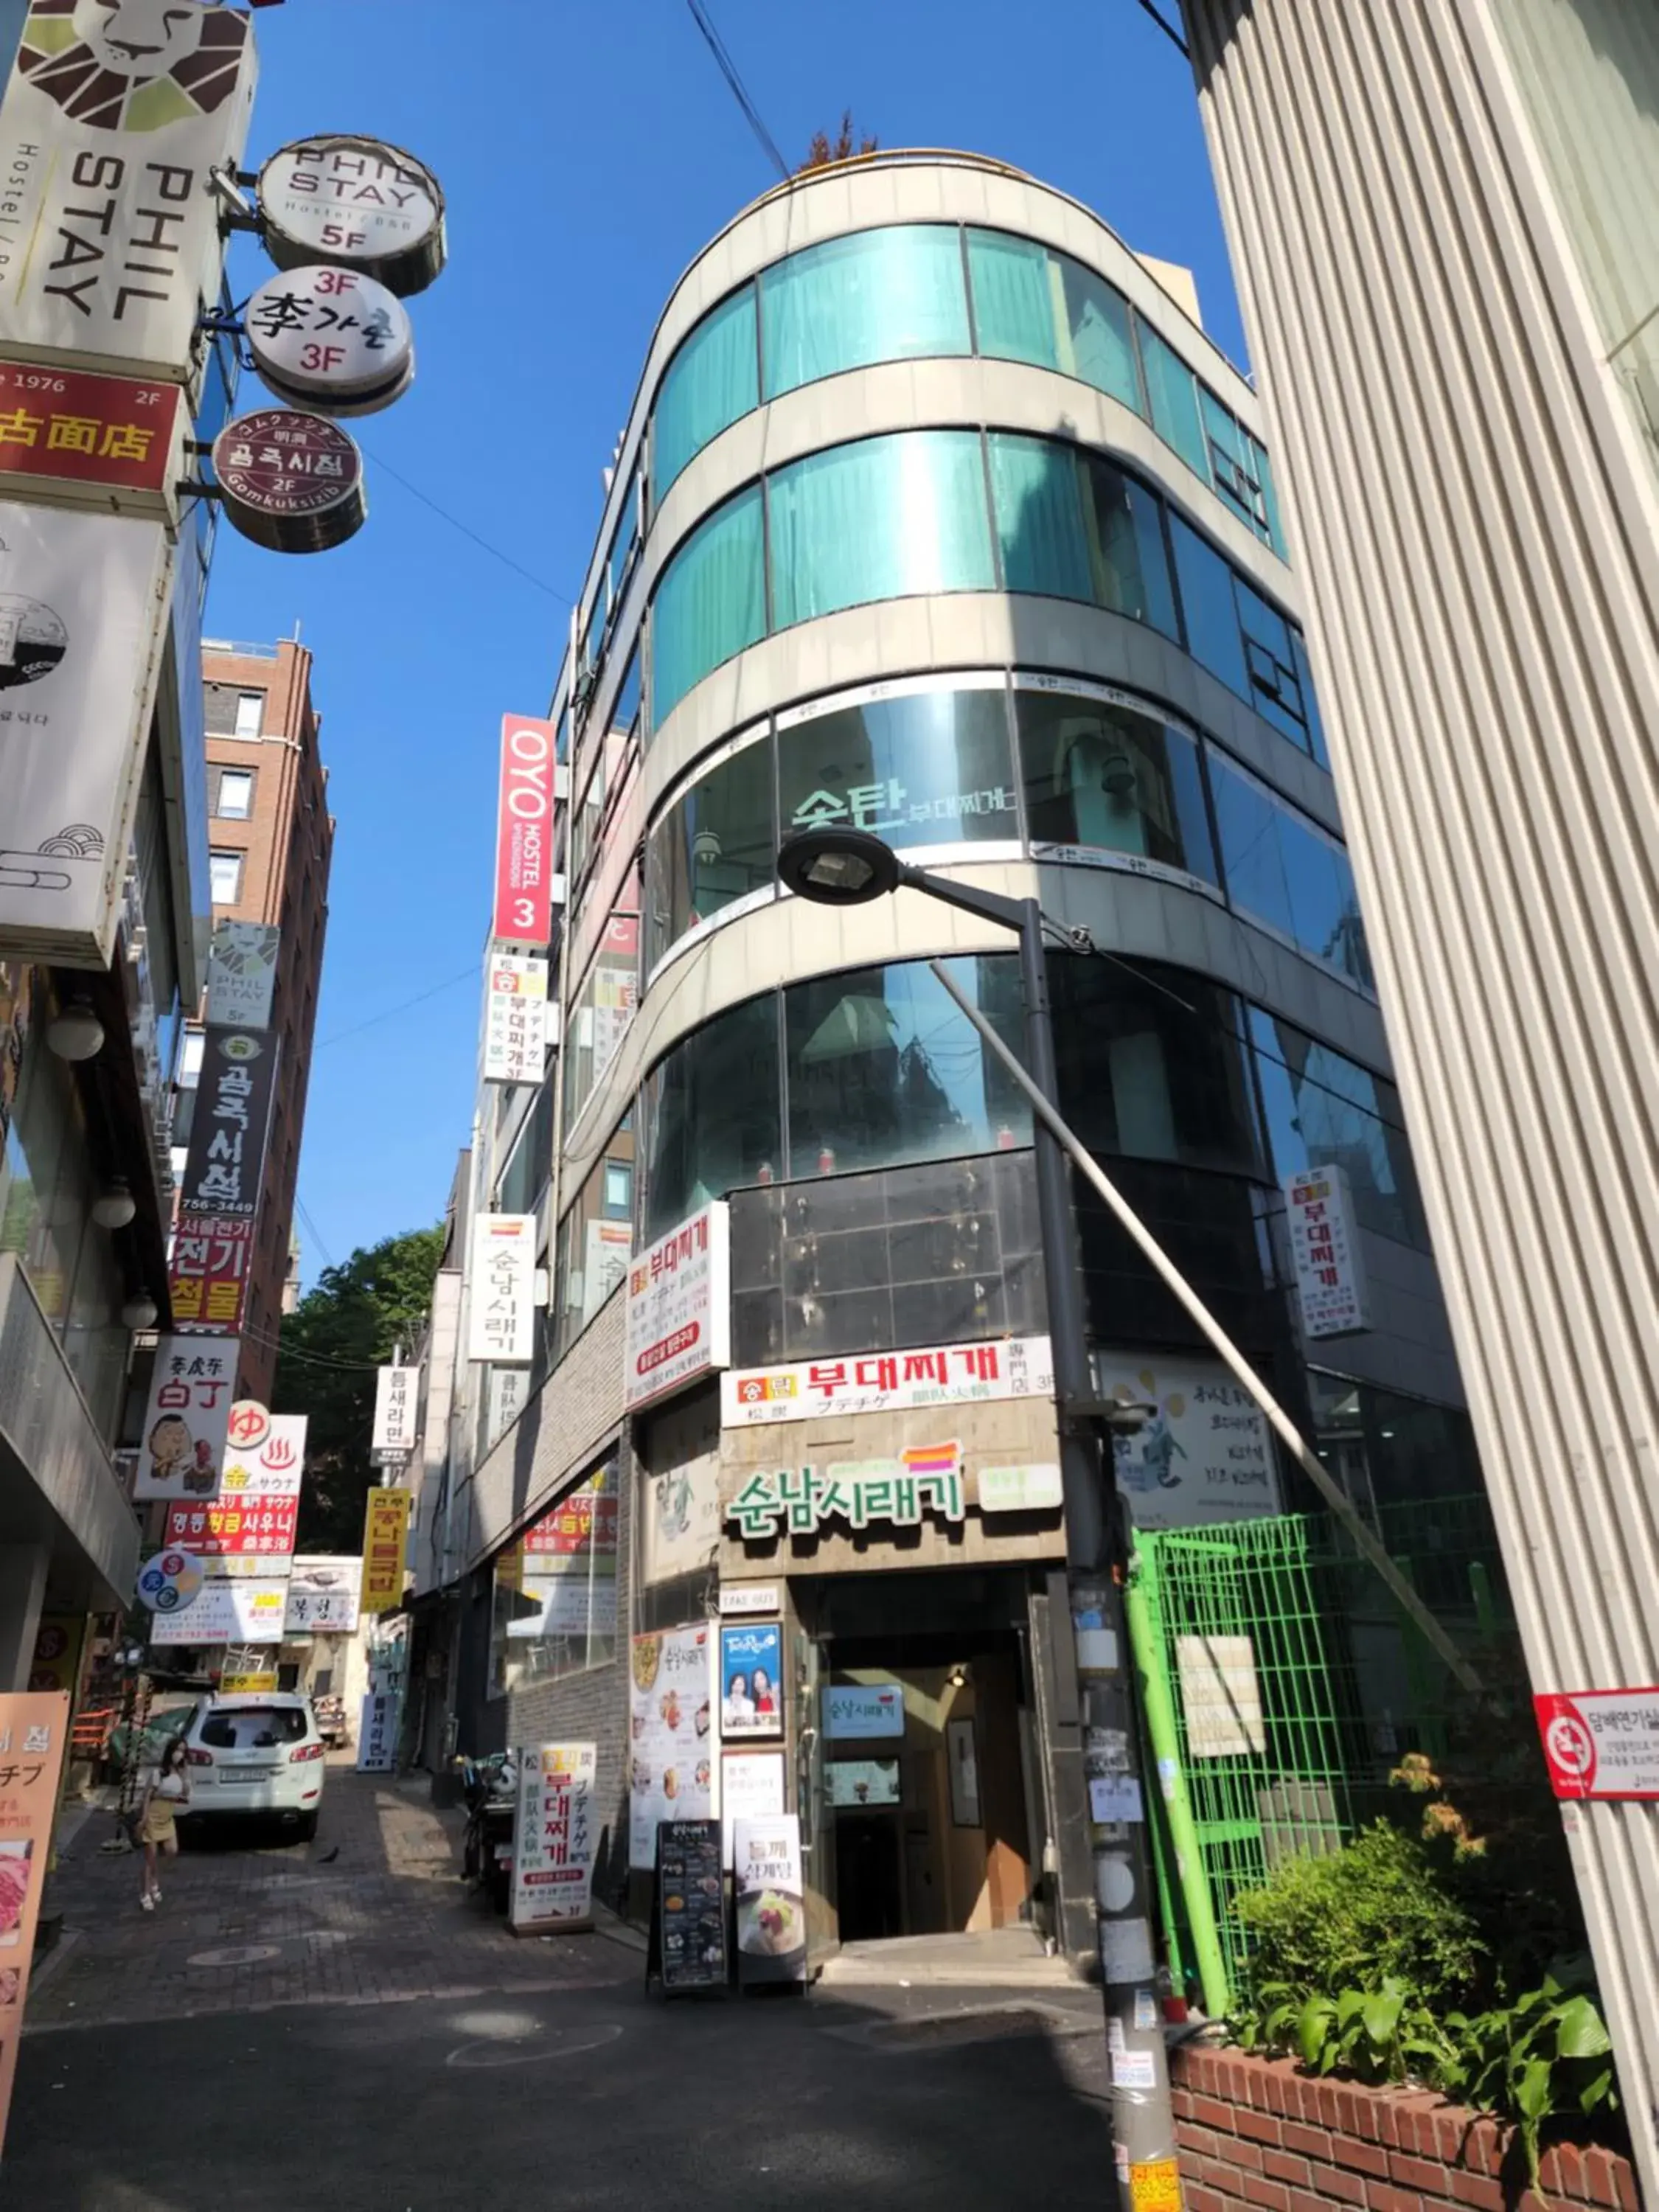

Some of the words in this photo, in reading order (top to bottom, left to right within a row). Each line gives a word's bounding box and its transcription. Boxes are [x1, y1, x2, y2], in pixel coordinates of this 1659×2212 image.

[288, 172, 418, 208] STAY
[44, 152, 125, 317] STAY
[113, 162, 194, 320] PHIL
[320, 224, 366, 248] 5F
[314, 271, 358, 295] 3F
[299, 343, 347, 372] 3F
[13, 374, 66, 393] 1976
[135, 390, 161, 405] 2F
[273, 479, 296, 493] 2F
[508, 730, 548, 819] OYO
[522, 824, 542, 890] HOSTEL
[512, 898, 535, 928] 3
[214, 986, 265, 1001] STAY
[216, 975, 266, 990] PHIL
[177, 1237, 245, 1278] 전기
[650, 1215, 709, 1283] 부대찌개
[170, 1279, 240, 1321] 철물
[484, 1250, 521, 1353] 순남시래기
[807, 1346, 999, 1397] 부대찌개
[158, 1377, 229, 1409] 白丁
[229, 1408, 265, 1441] ゆ
[730, 1467, 961, 1533] 순남시래기
[543, 1773, 571, 1865] 부대찌개
